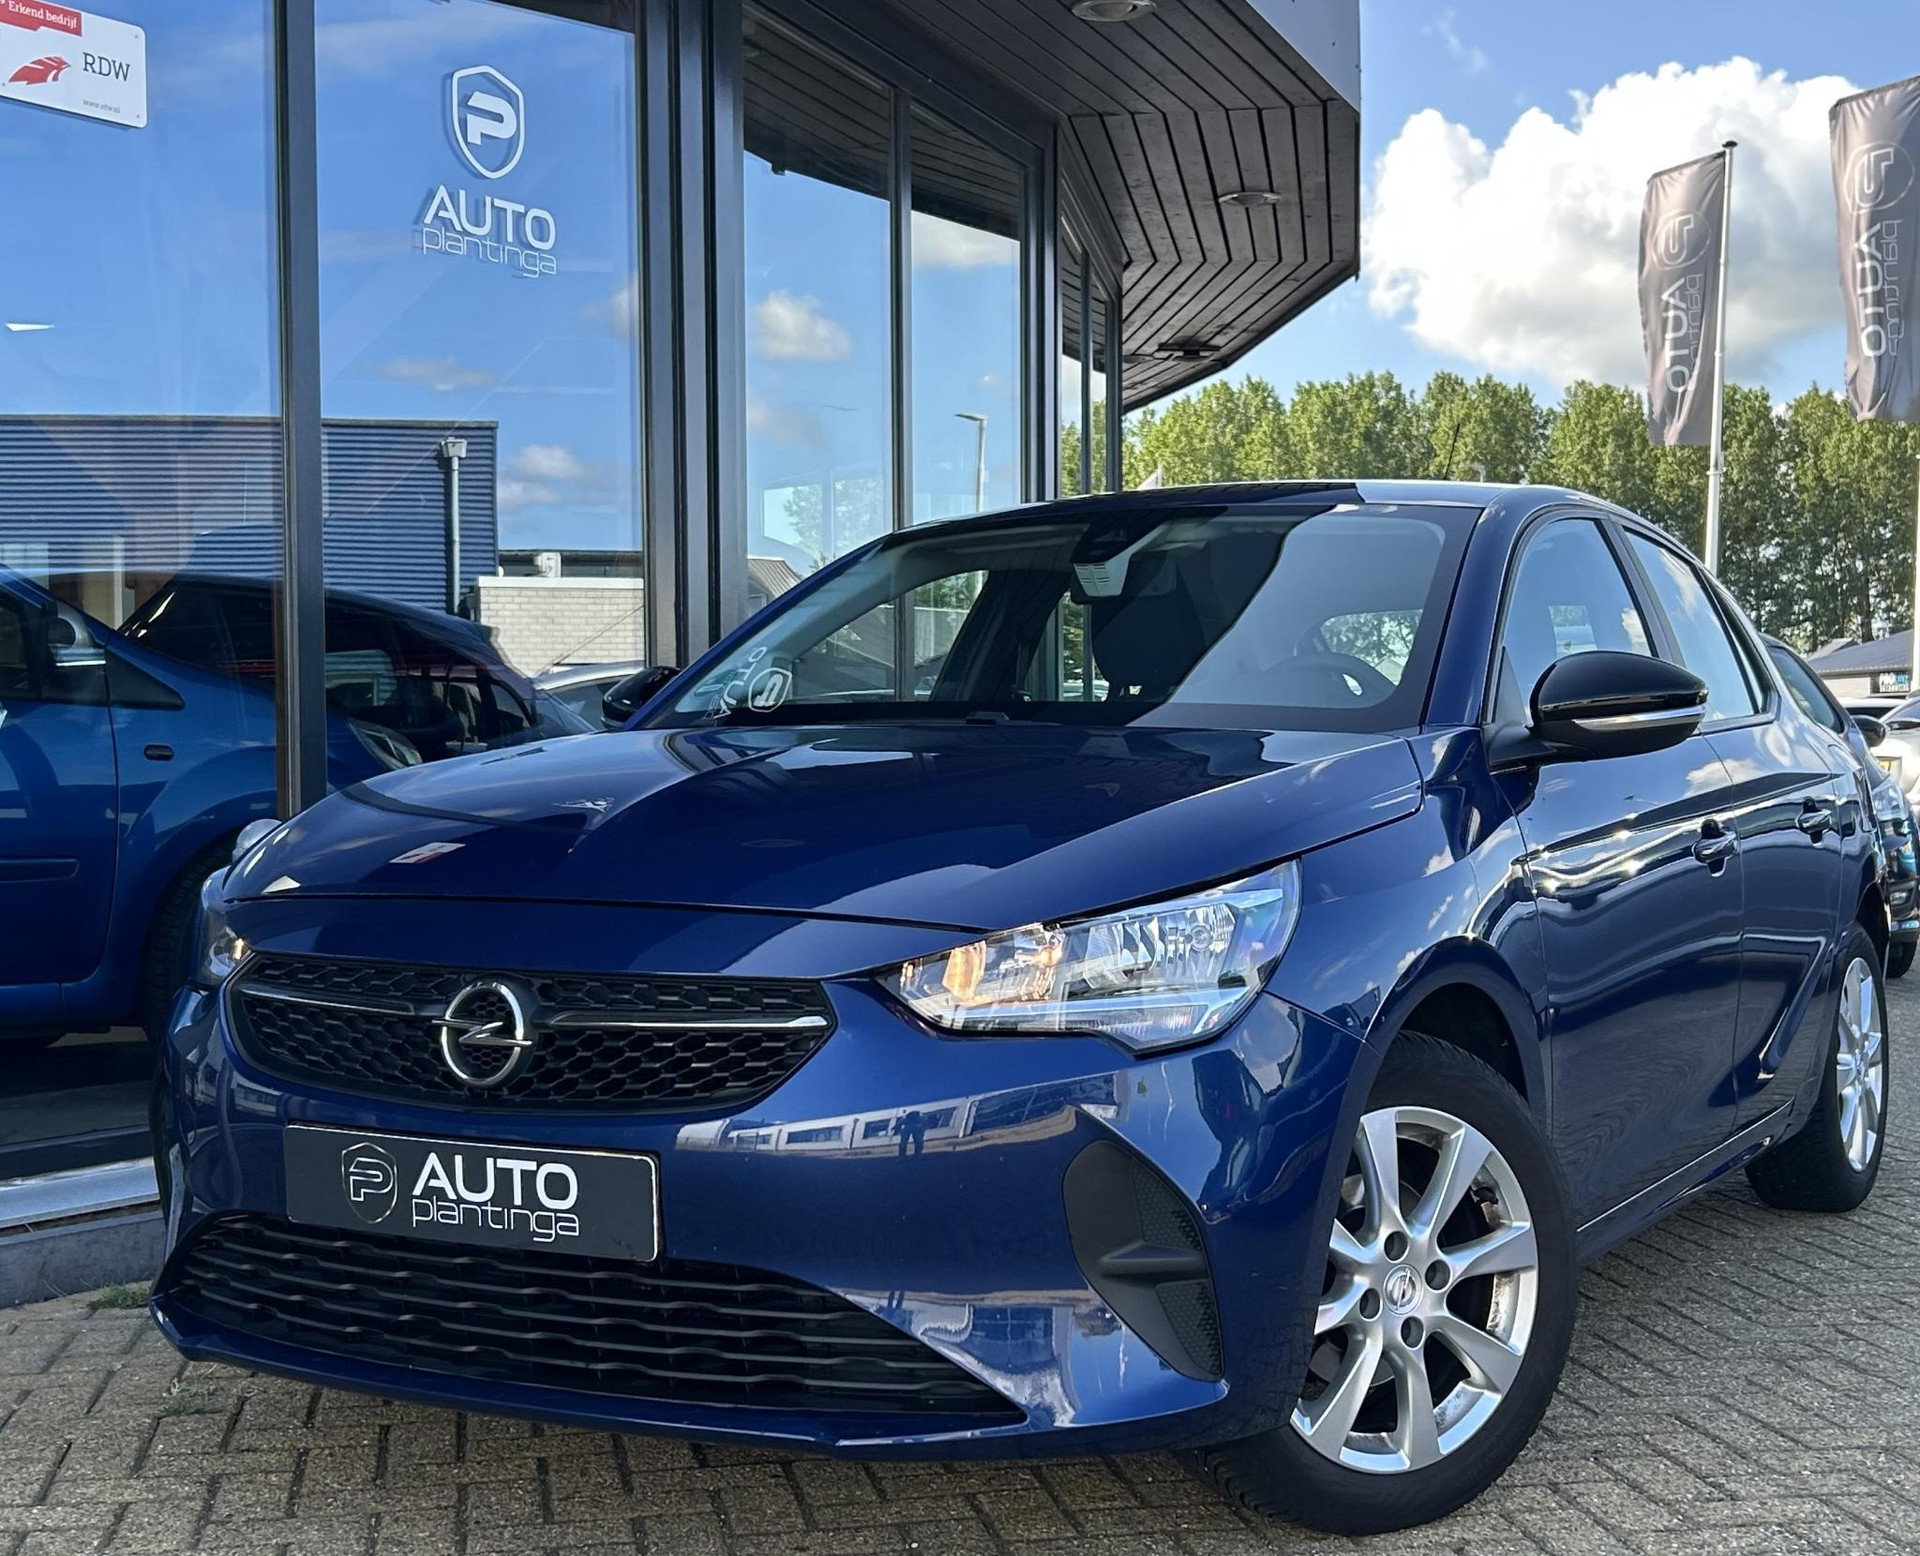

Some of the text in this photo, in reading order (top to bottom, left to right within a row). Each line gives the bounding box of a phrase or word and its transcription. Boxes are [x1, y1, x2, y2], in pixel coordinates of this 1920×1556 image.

[8, 1, 77, 29] Erkend bedrijf
[82, 52, 130, 82] RDW
[466, 91, 517, 146] P
[423, 184, 556, 250] AUTO
[422, 227, 557, 278] plantinga
[348, 1157, 394, 1202] P
[413, 1152, 579, 1210] AUTO
[412, 1197, 580, 1243] plantinga
